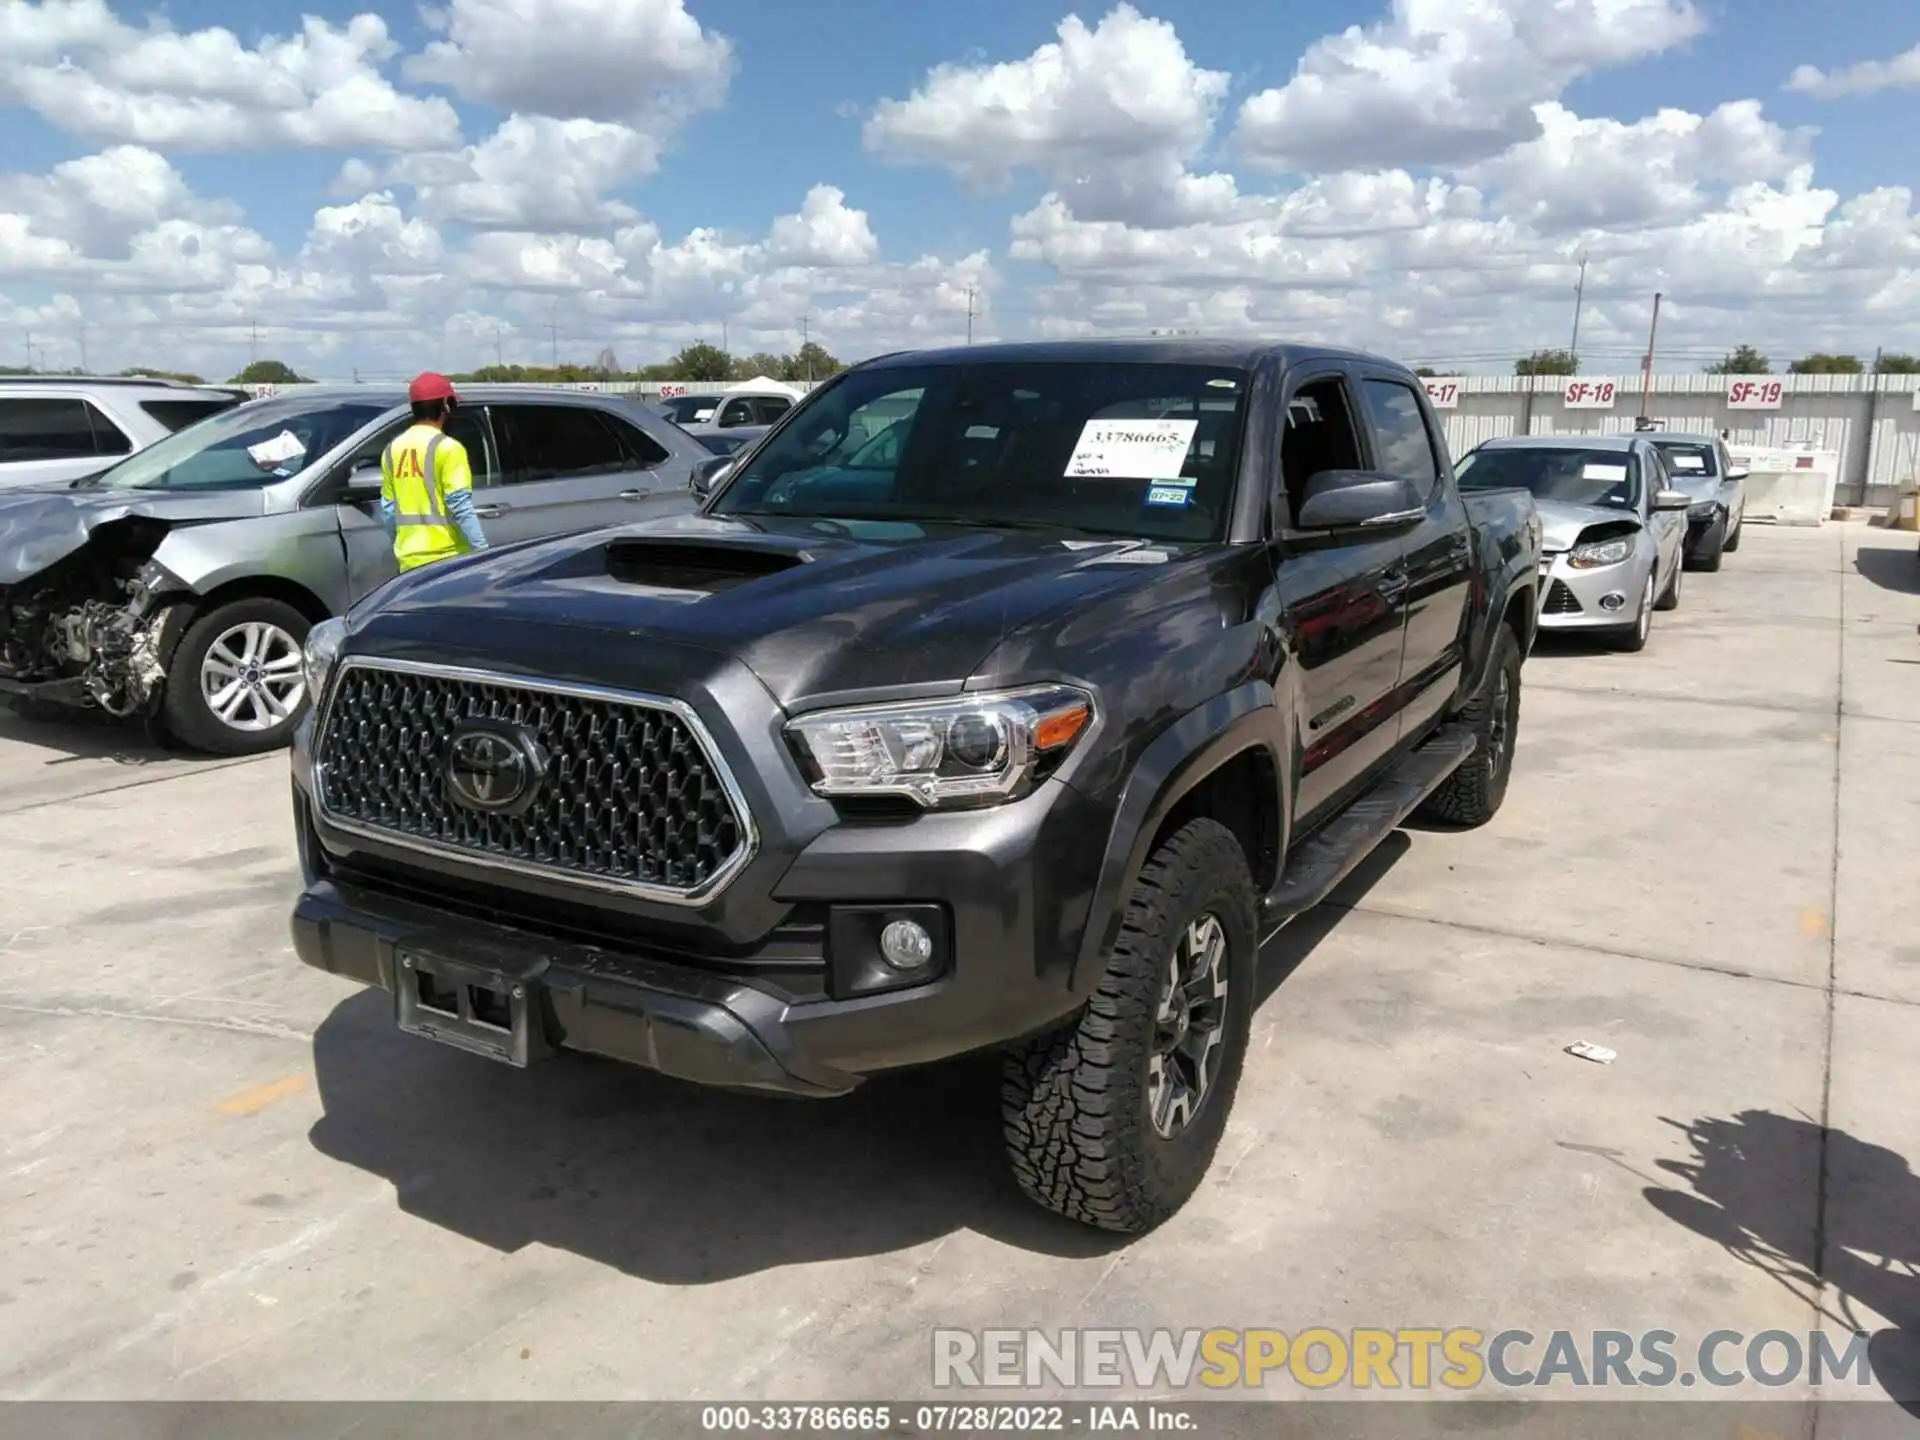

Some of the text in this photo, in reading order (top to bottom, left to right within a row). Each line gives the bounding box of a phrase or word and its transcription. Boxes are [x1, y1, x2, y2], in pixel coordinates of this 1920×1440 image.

[1426, 384, 1457, 403] F-17
[1566, 383, 1614, 403] SF-18
[1730, 382, 1782, 403] SF-19
